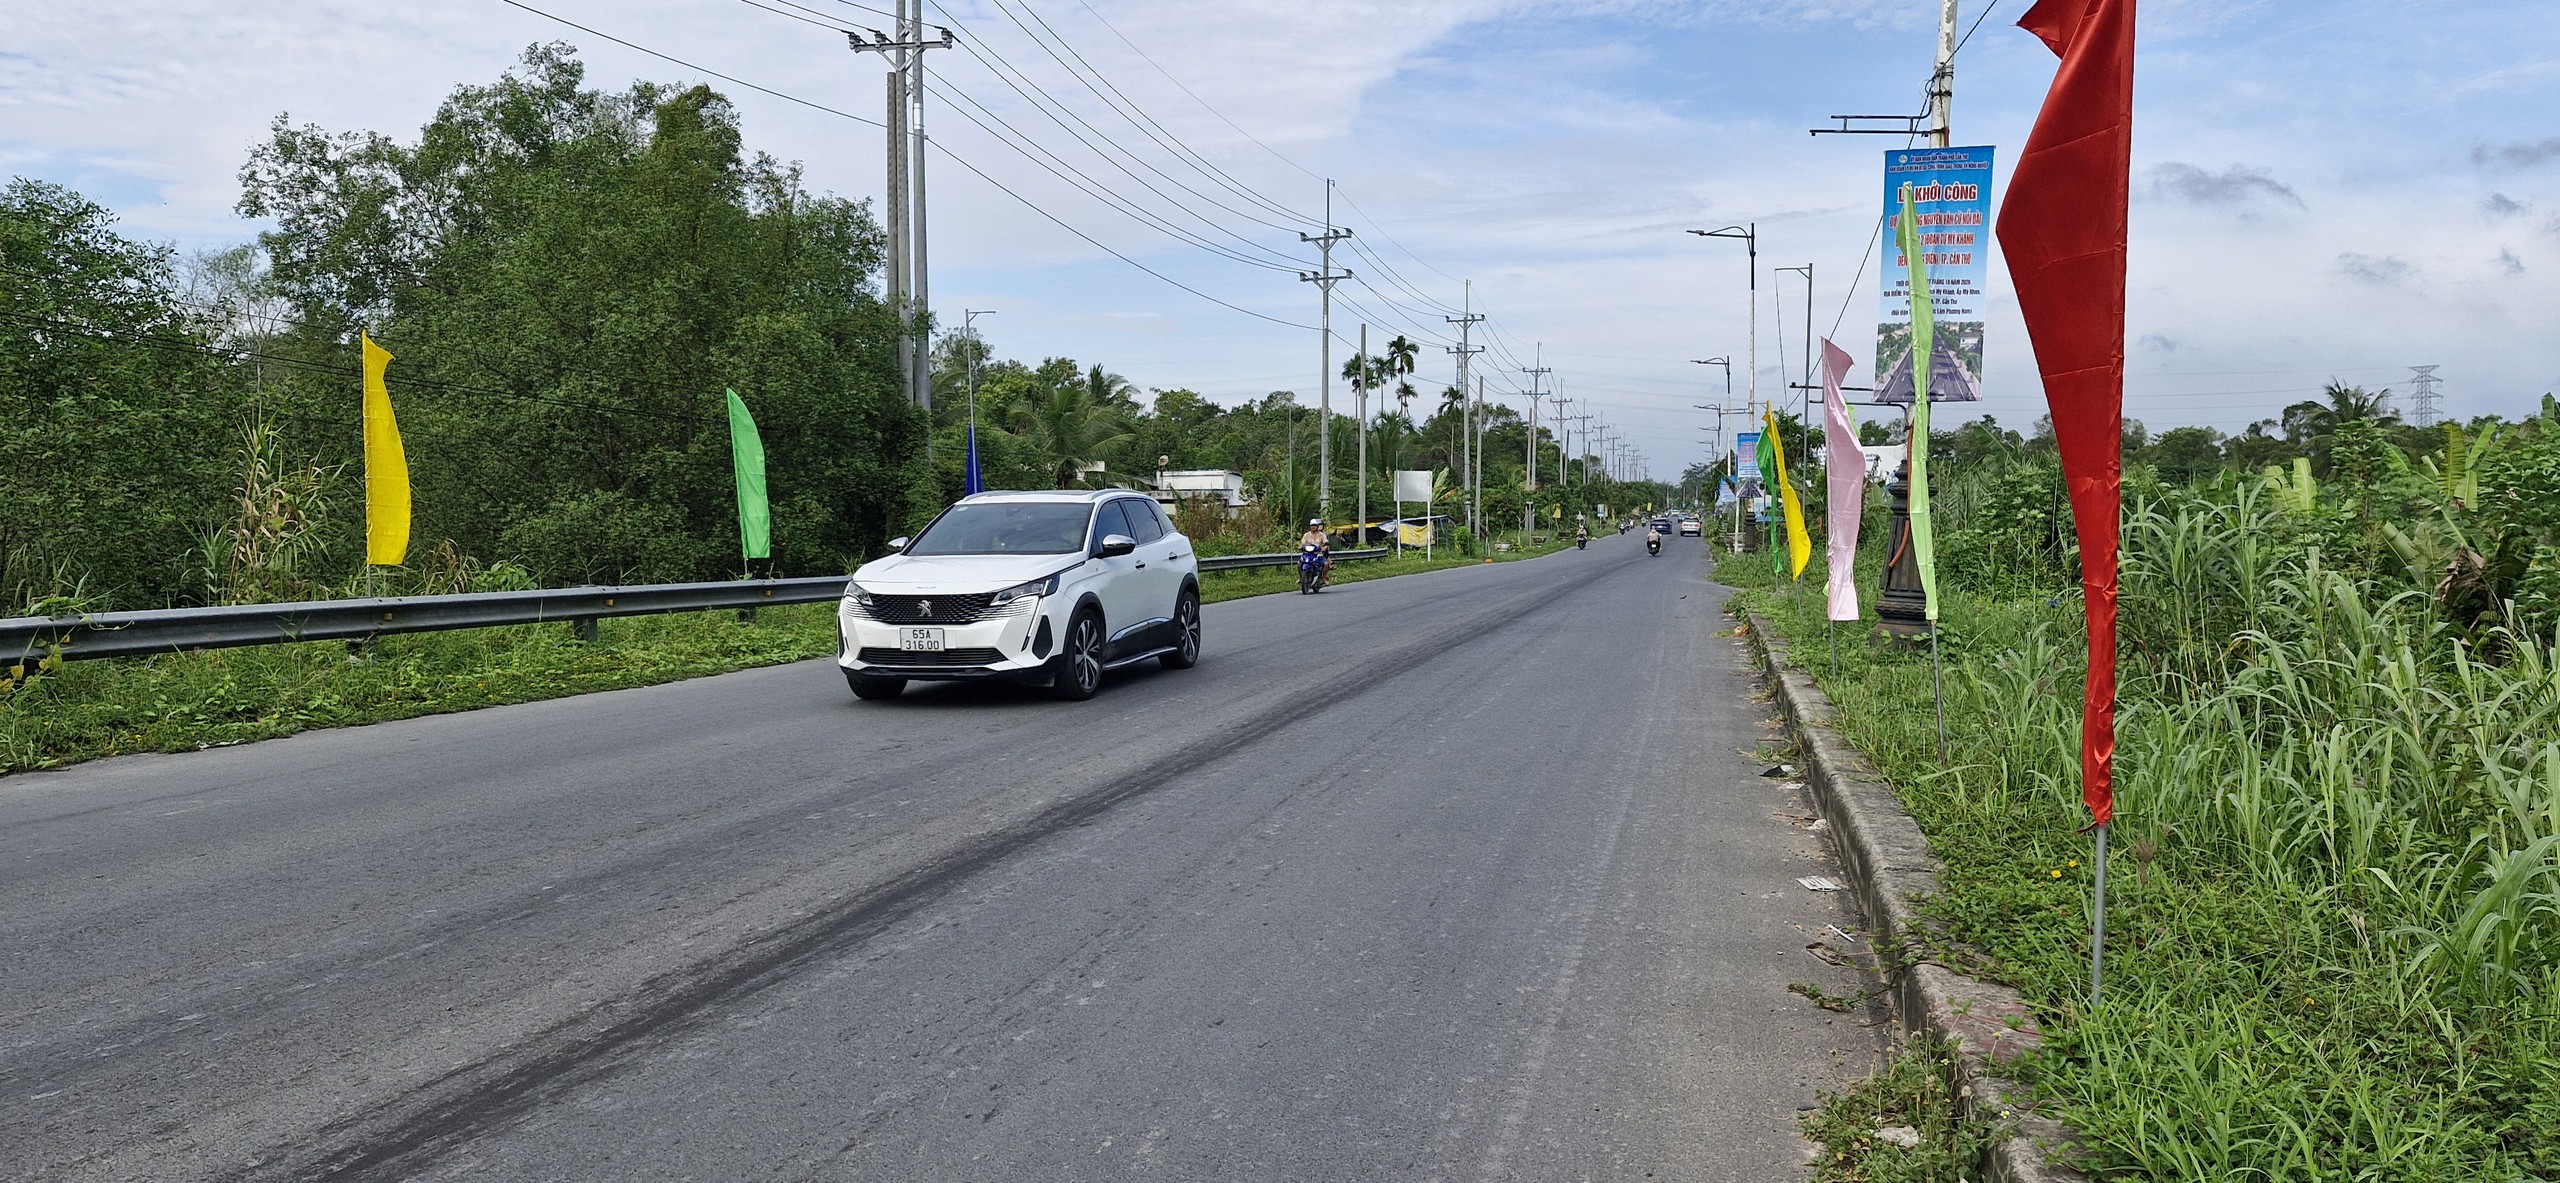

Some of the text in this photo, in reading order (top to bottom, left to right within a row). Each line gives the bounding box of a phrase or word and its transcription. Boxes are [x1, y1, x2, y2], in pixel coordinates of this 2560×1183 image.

[1915, 181, 1941, 202] KHỞI
[1944, 182, 1977, 201] CÔNG
[912, 629, 931, 639] 65A
[905, 640, 940, 650] 316.00
